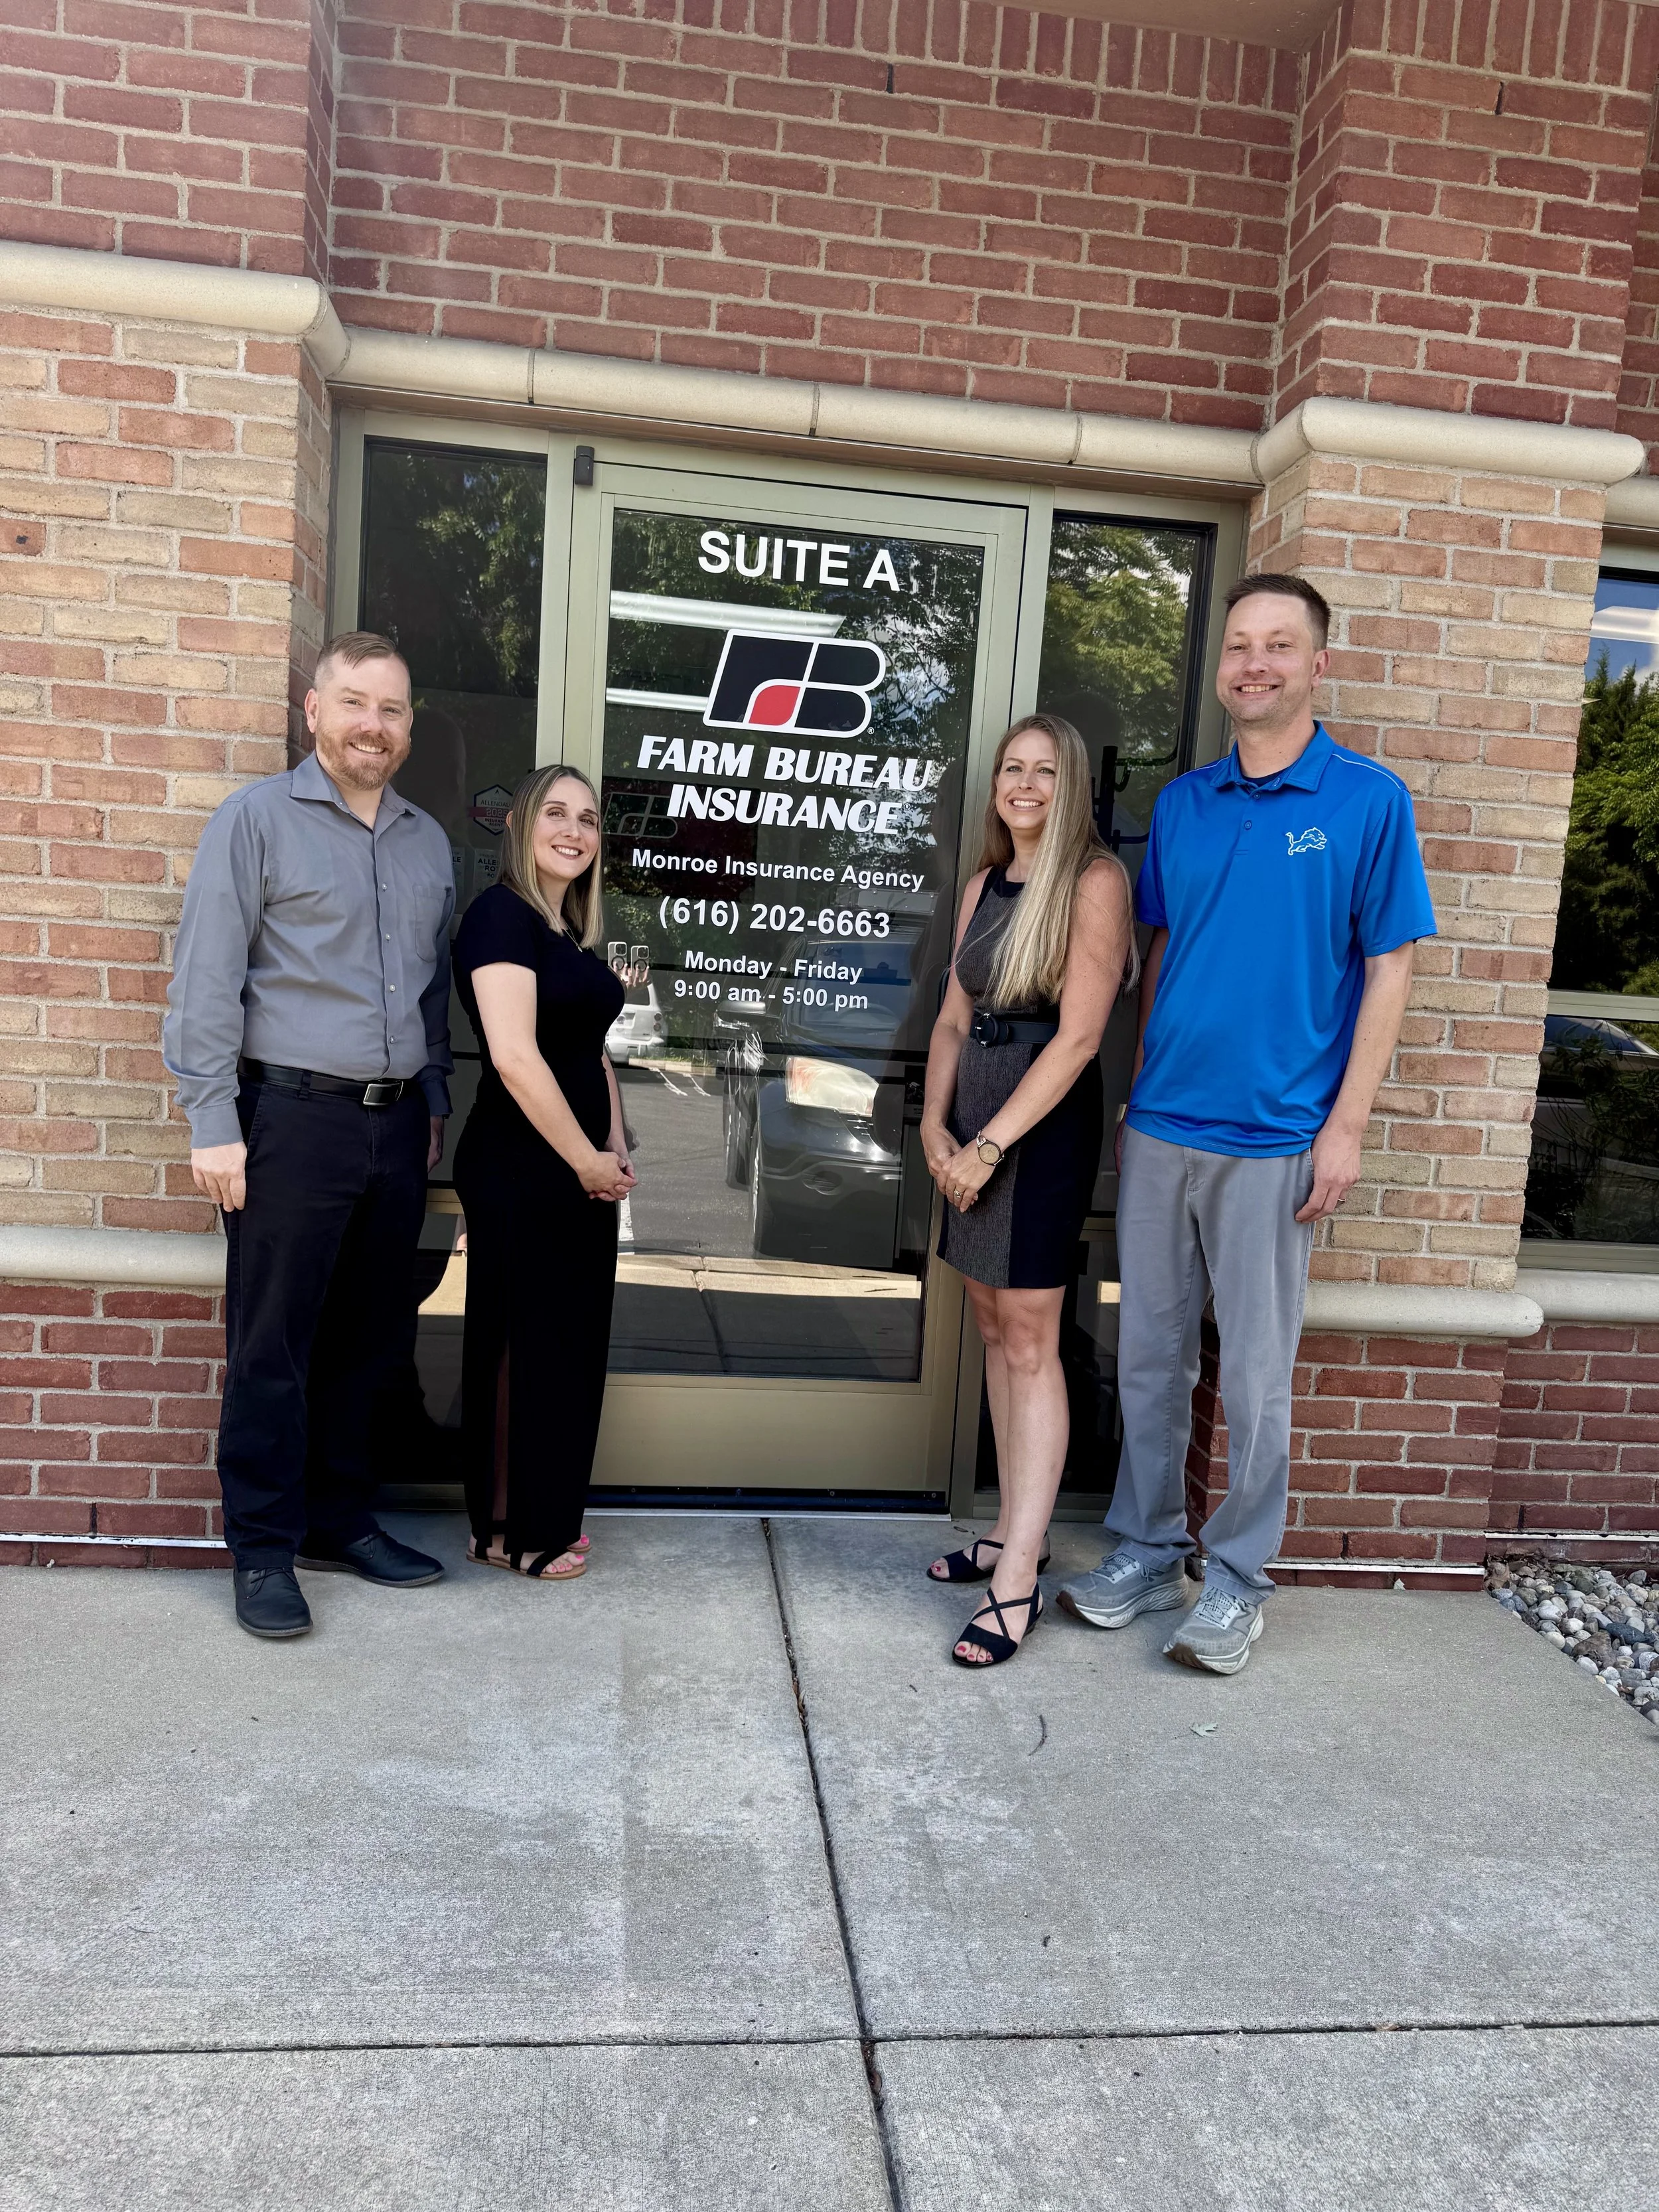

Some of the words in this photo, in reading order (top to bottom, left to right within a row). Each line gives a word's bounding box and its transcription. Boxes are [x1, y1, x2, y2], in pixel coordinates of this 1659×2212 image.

[698, 530, 851, 587] SUITE
[863, 550, 901, 591] A
[637, 735, 755, 778] FARM
[764, 747, 932, 792] BUREAU
[632, 848, 718, 874] Monroe
[725, 855, 835, 882] Insurance
[840, 865, 924, 893] Agency
[660, 895, 739, 934] (616)
[749, 903, 890, 938] 202-6663
[685, 950, 773, 980] Monday
[794, 958, 863, 985] Friday
[674, 979, 721, 1000] 9:00
[728, 987, 760, 1002] am
[782, 986, 828, 1007] 5:00
[835, 994, 868, 1012] pm
